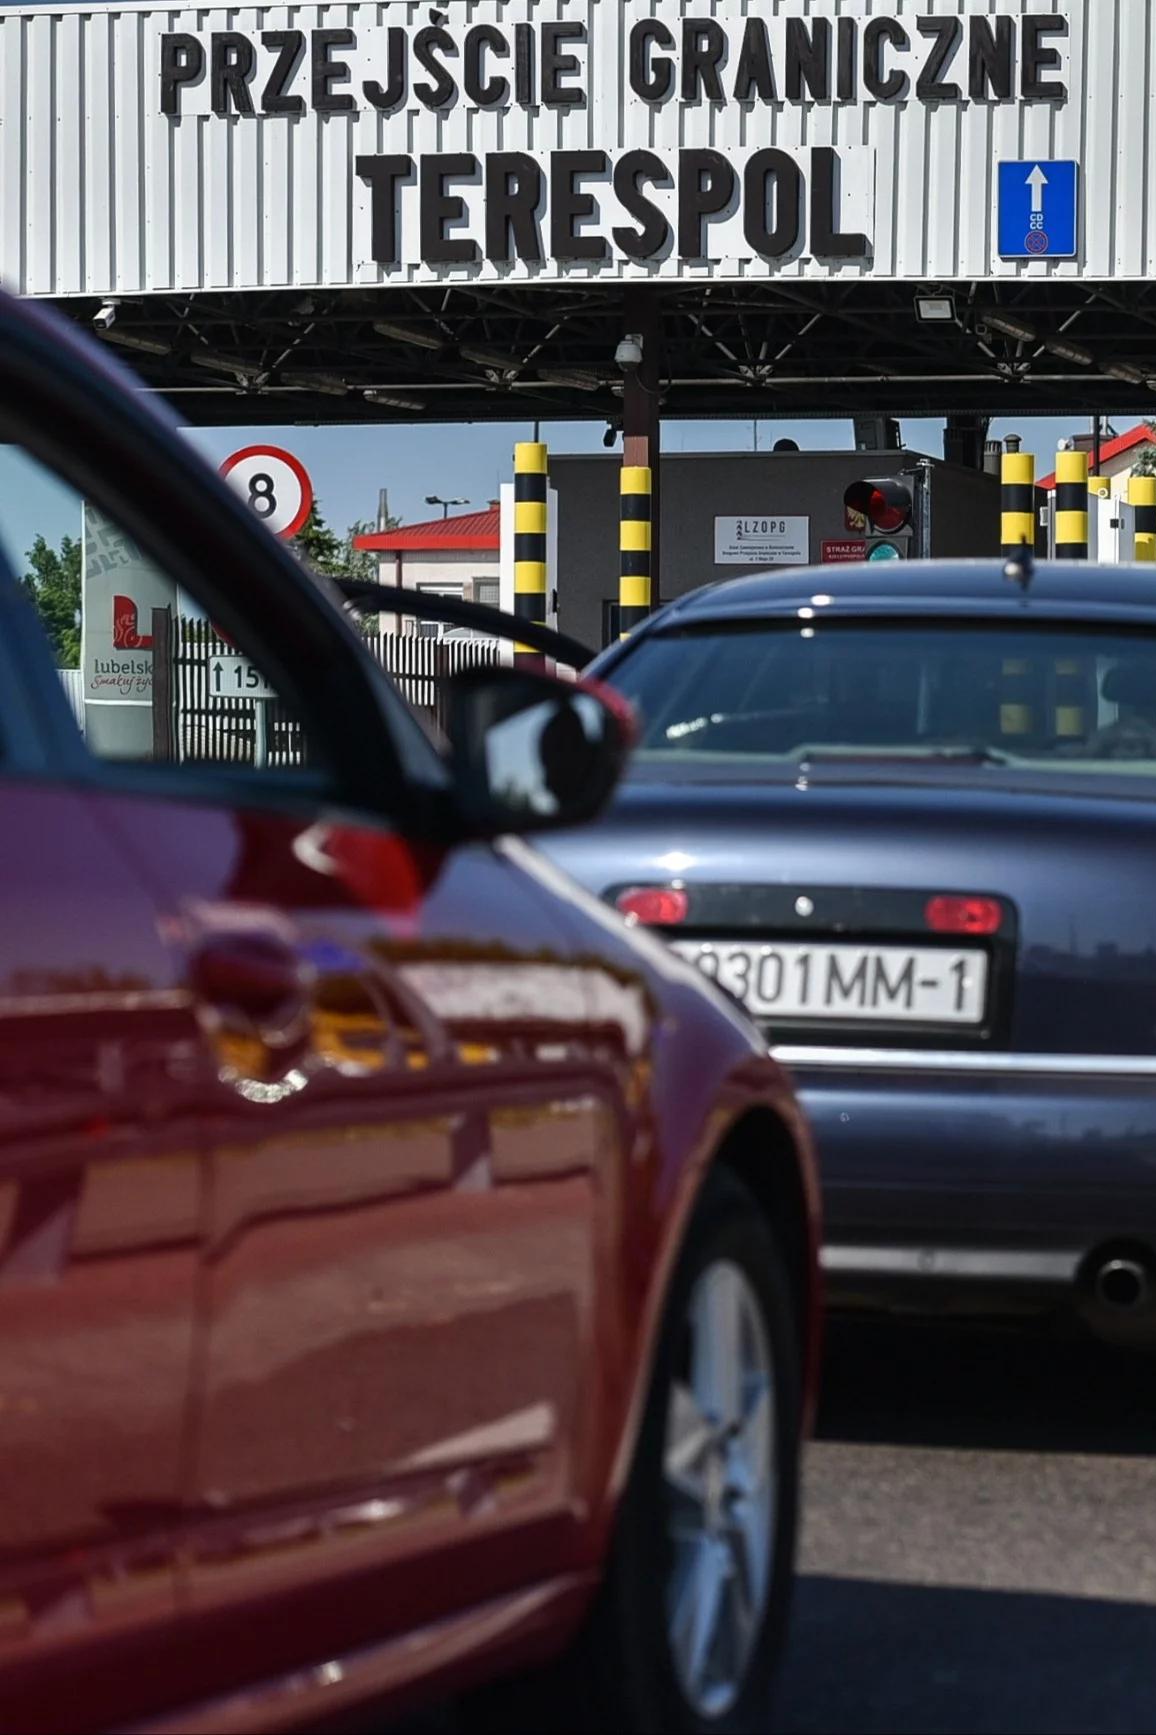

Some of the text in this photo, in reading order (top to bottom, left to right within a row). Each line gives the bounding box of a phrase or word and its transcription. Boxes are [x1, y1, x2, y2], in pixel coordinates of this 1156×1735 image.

[160, 8, 1070, 116] PRZEJŚCIE GRANICZNE
[355, 146, 874, 264] TERESPOL
[1029, 213, 1044, 221] CD
[1029, 221, 1044, 230] CC
[247, 472, 277, 520] 8
[744, 520, 786, 533] LZOPG
[234, 665, 269, 689] 15
